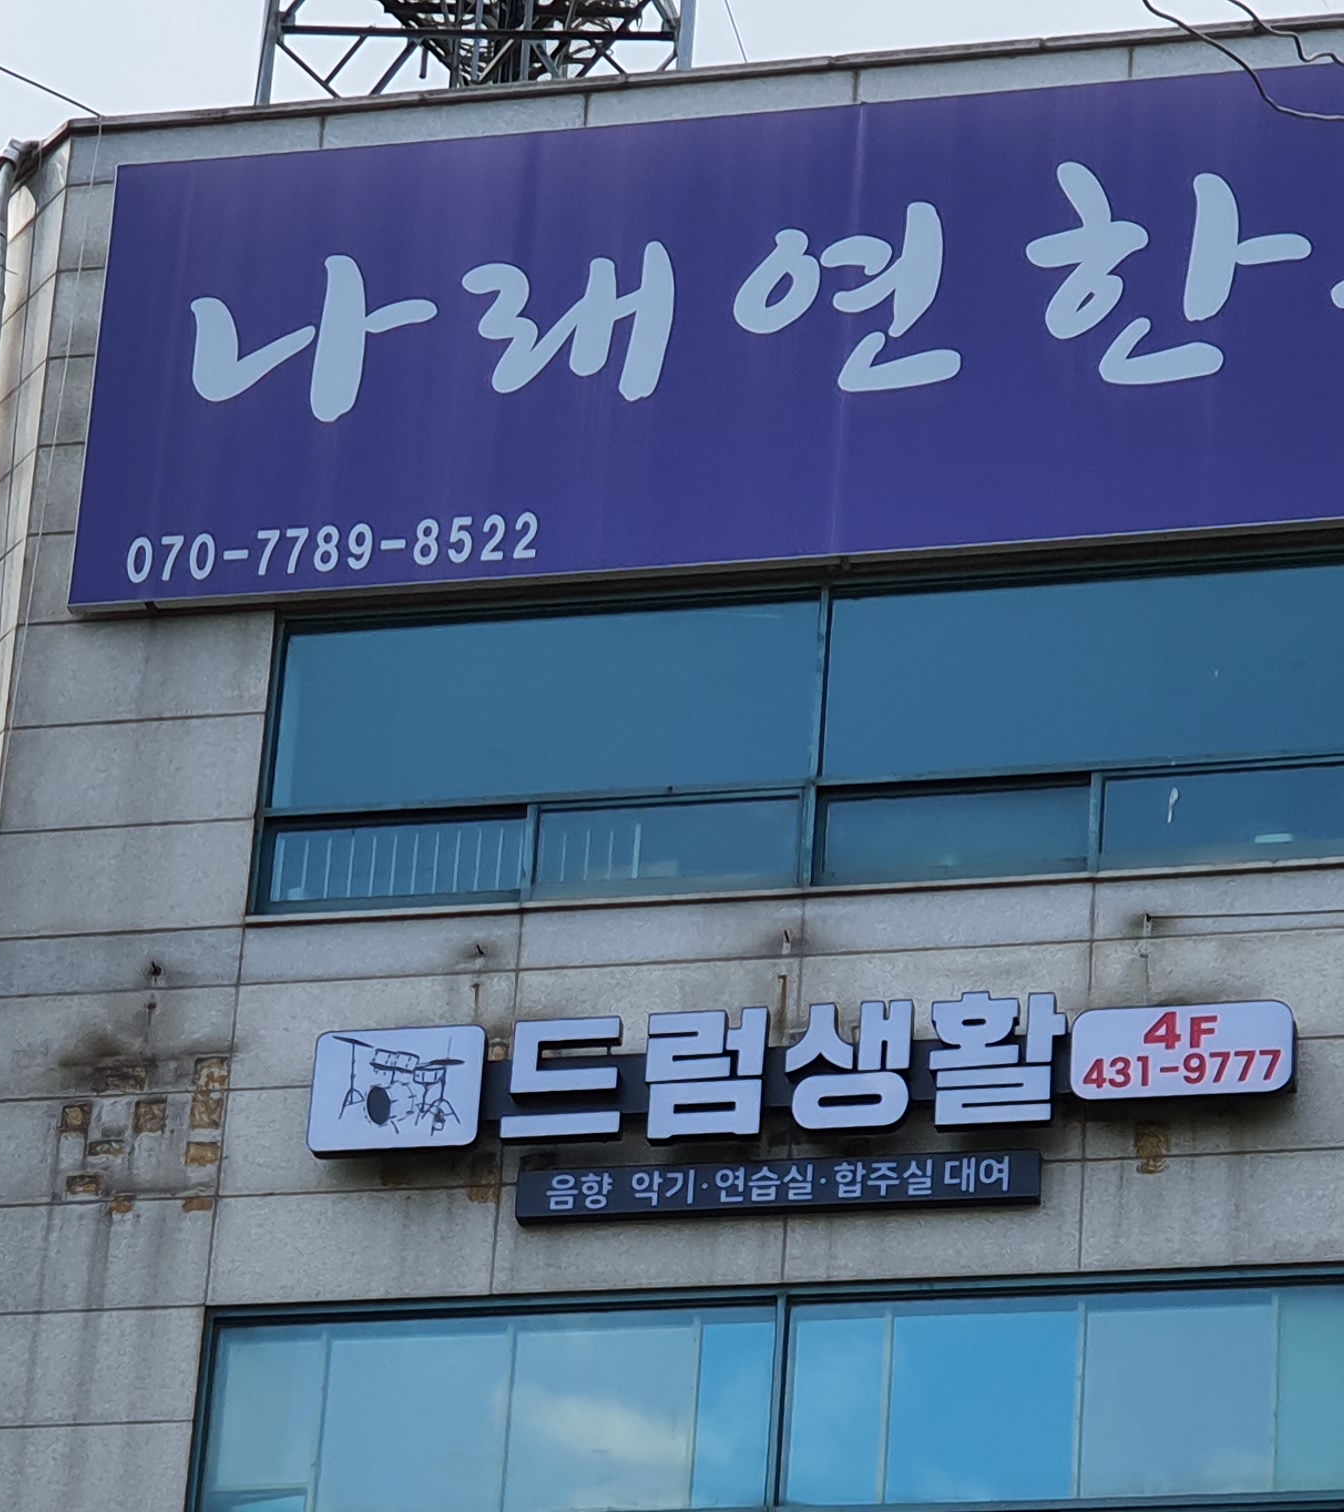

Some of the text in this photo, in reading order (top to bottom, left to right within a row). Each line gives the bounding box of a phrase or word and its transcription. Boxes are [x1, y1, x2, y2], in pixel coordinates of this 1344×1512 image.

[125, 512, 539, 585] 070-7789-8522
[1143, 1011, 1219, 1051] 4F
[499, 990, 1068, 1140] 드럼생활
[1082, 1048, 1282, 1090] 431-9777
[544, 1171, 613, 1211] 음향
[943, 1154, 1010, 1194] 대여
